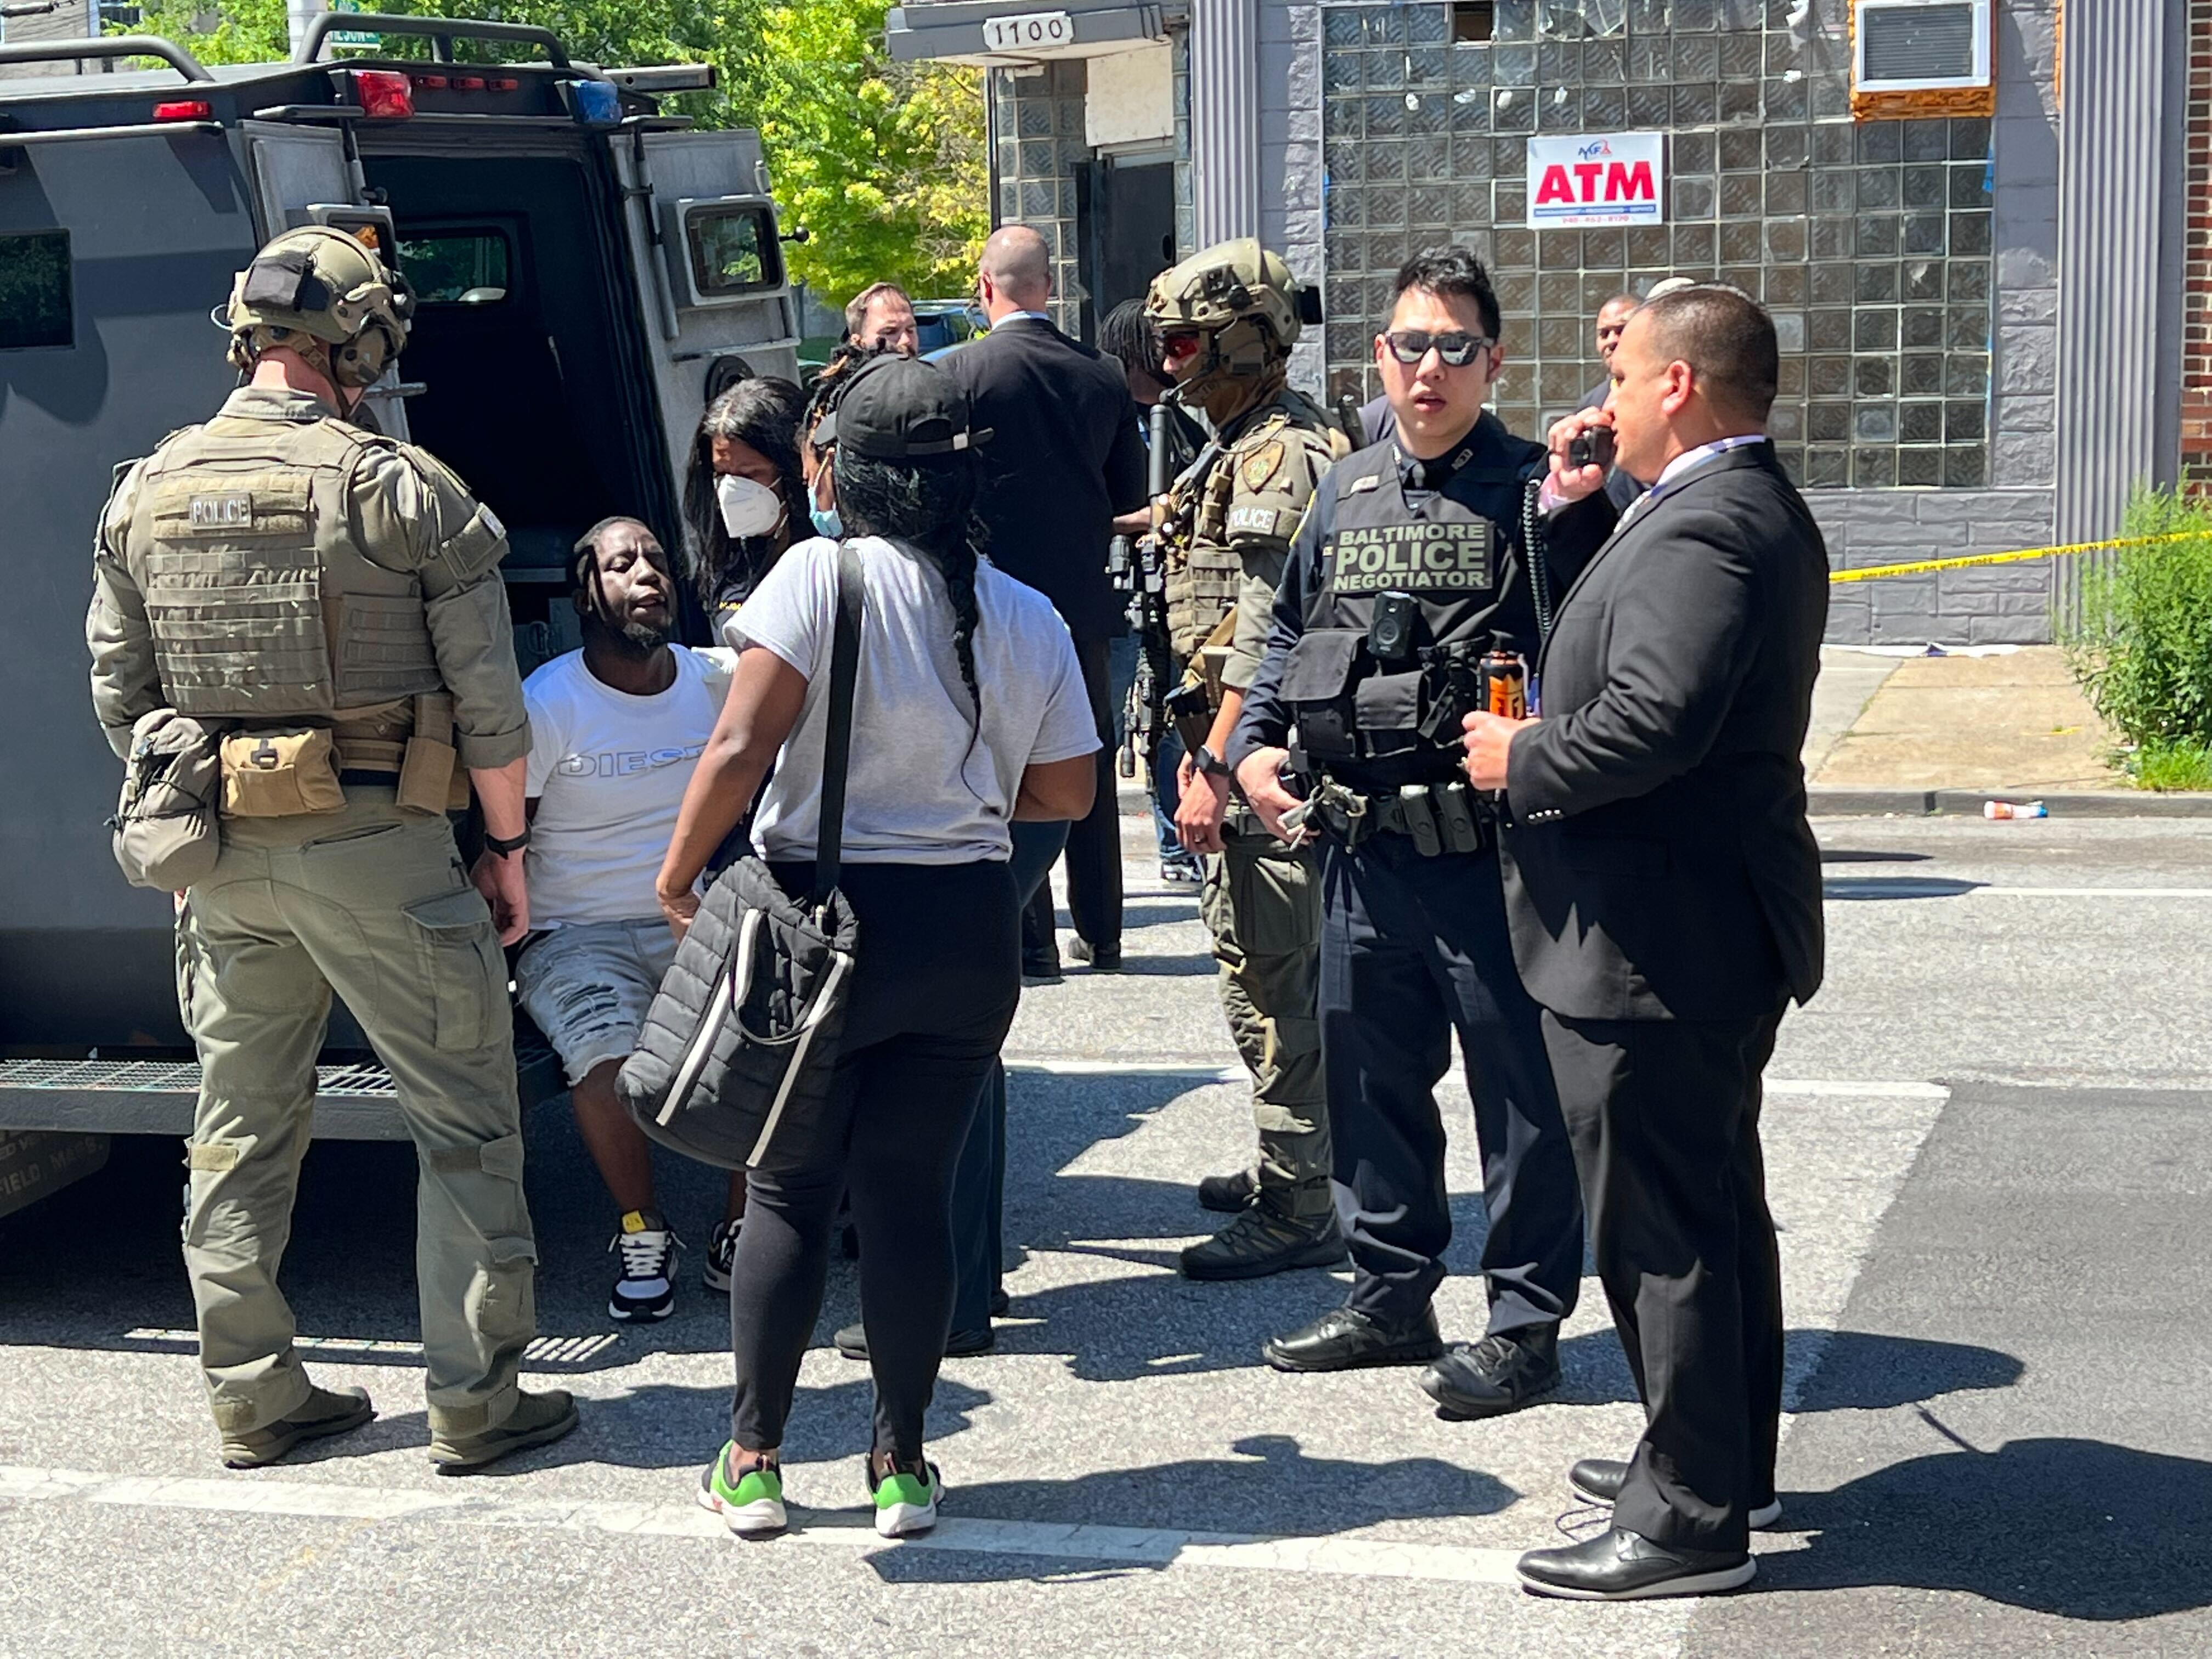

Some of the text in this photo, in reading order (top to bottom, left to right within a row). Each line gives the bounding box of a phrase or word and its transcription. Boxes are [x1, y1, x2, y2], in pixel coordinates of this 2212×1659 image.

[996, 19, 1062, 44] 1100
[1536, 161, 1655, 204] ATM
[193, 499, 248, 523] POLICE
[1231, 507, 1274, 529] POLICE
[1339, 524, 1485, 545] BALTIMORE
[1335, 541, 1486, 575] POLICE
[1333, 571, 1484, 591] NEGOTIATOR
[557, 742, 709, 777] DIESE
